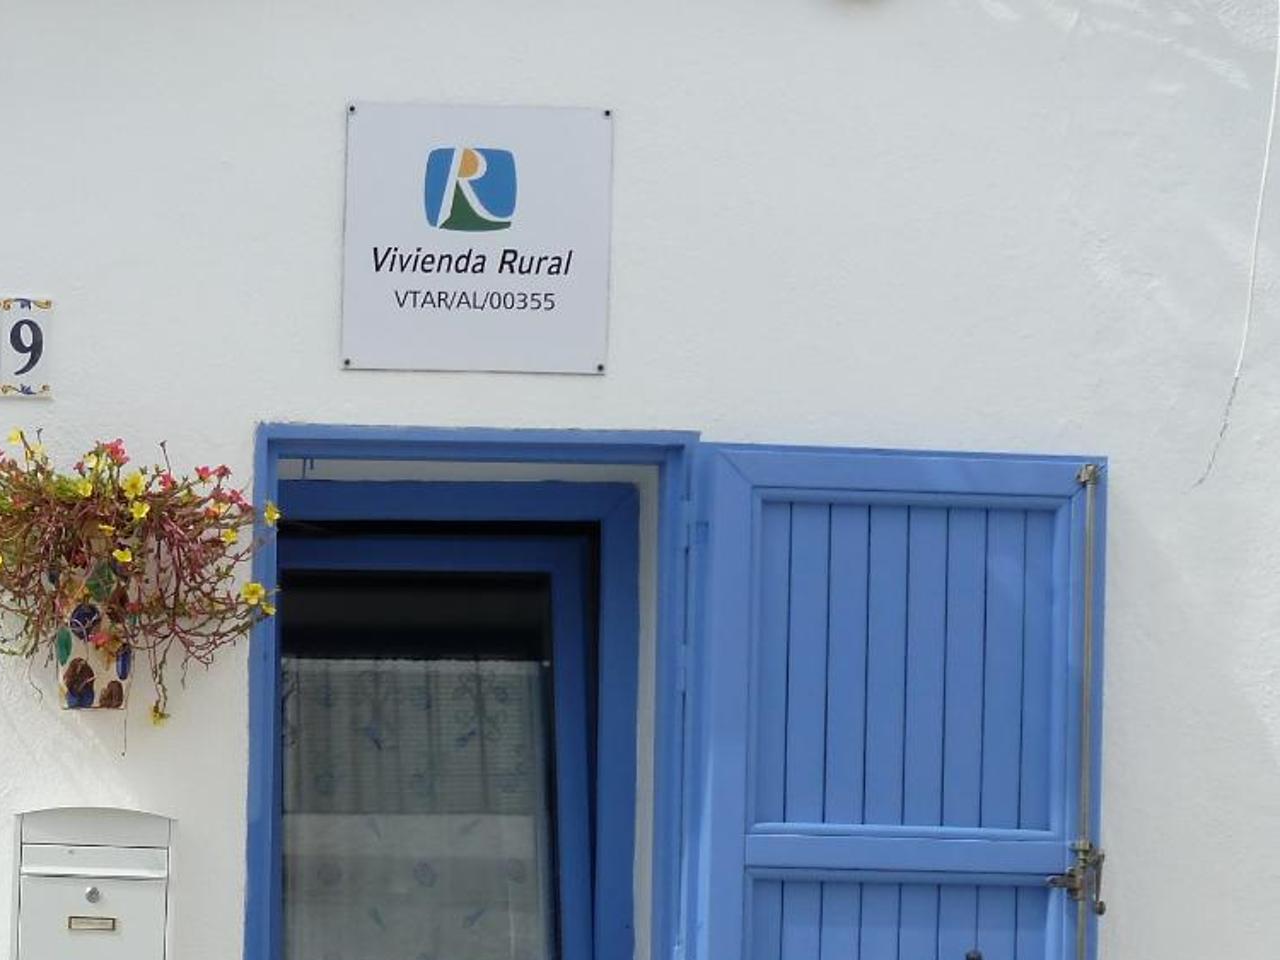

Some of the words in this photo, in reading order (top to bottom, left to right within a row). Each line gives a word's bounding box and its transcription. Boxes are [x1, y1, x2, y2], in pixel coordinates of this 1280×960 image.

[372, 247, 487, 274] Vivienda
[498, 249, 573, 276] Rural
[394, 290, 556, 311] VTAR/AL/00355
